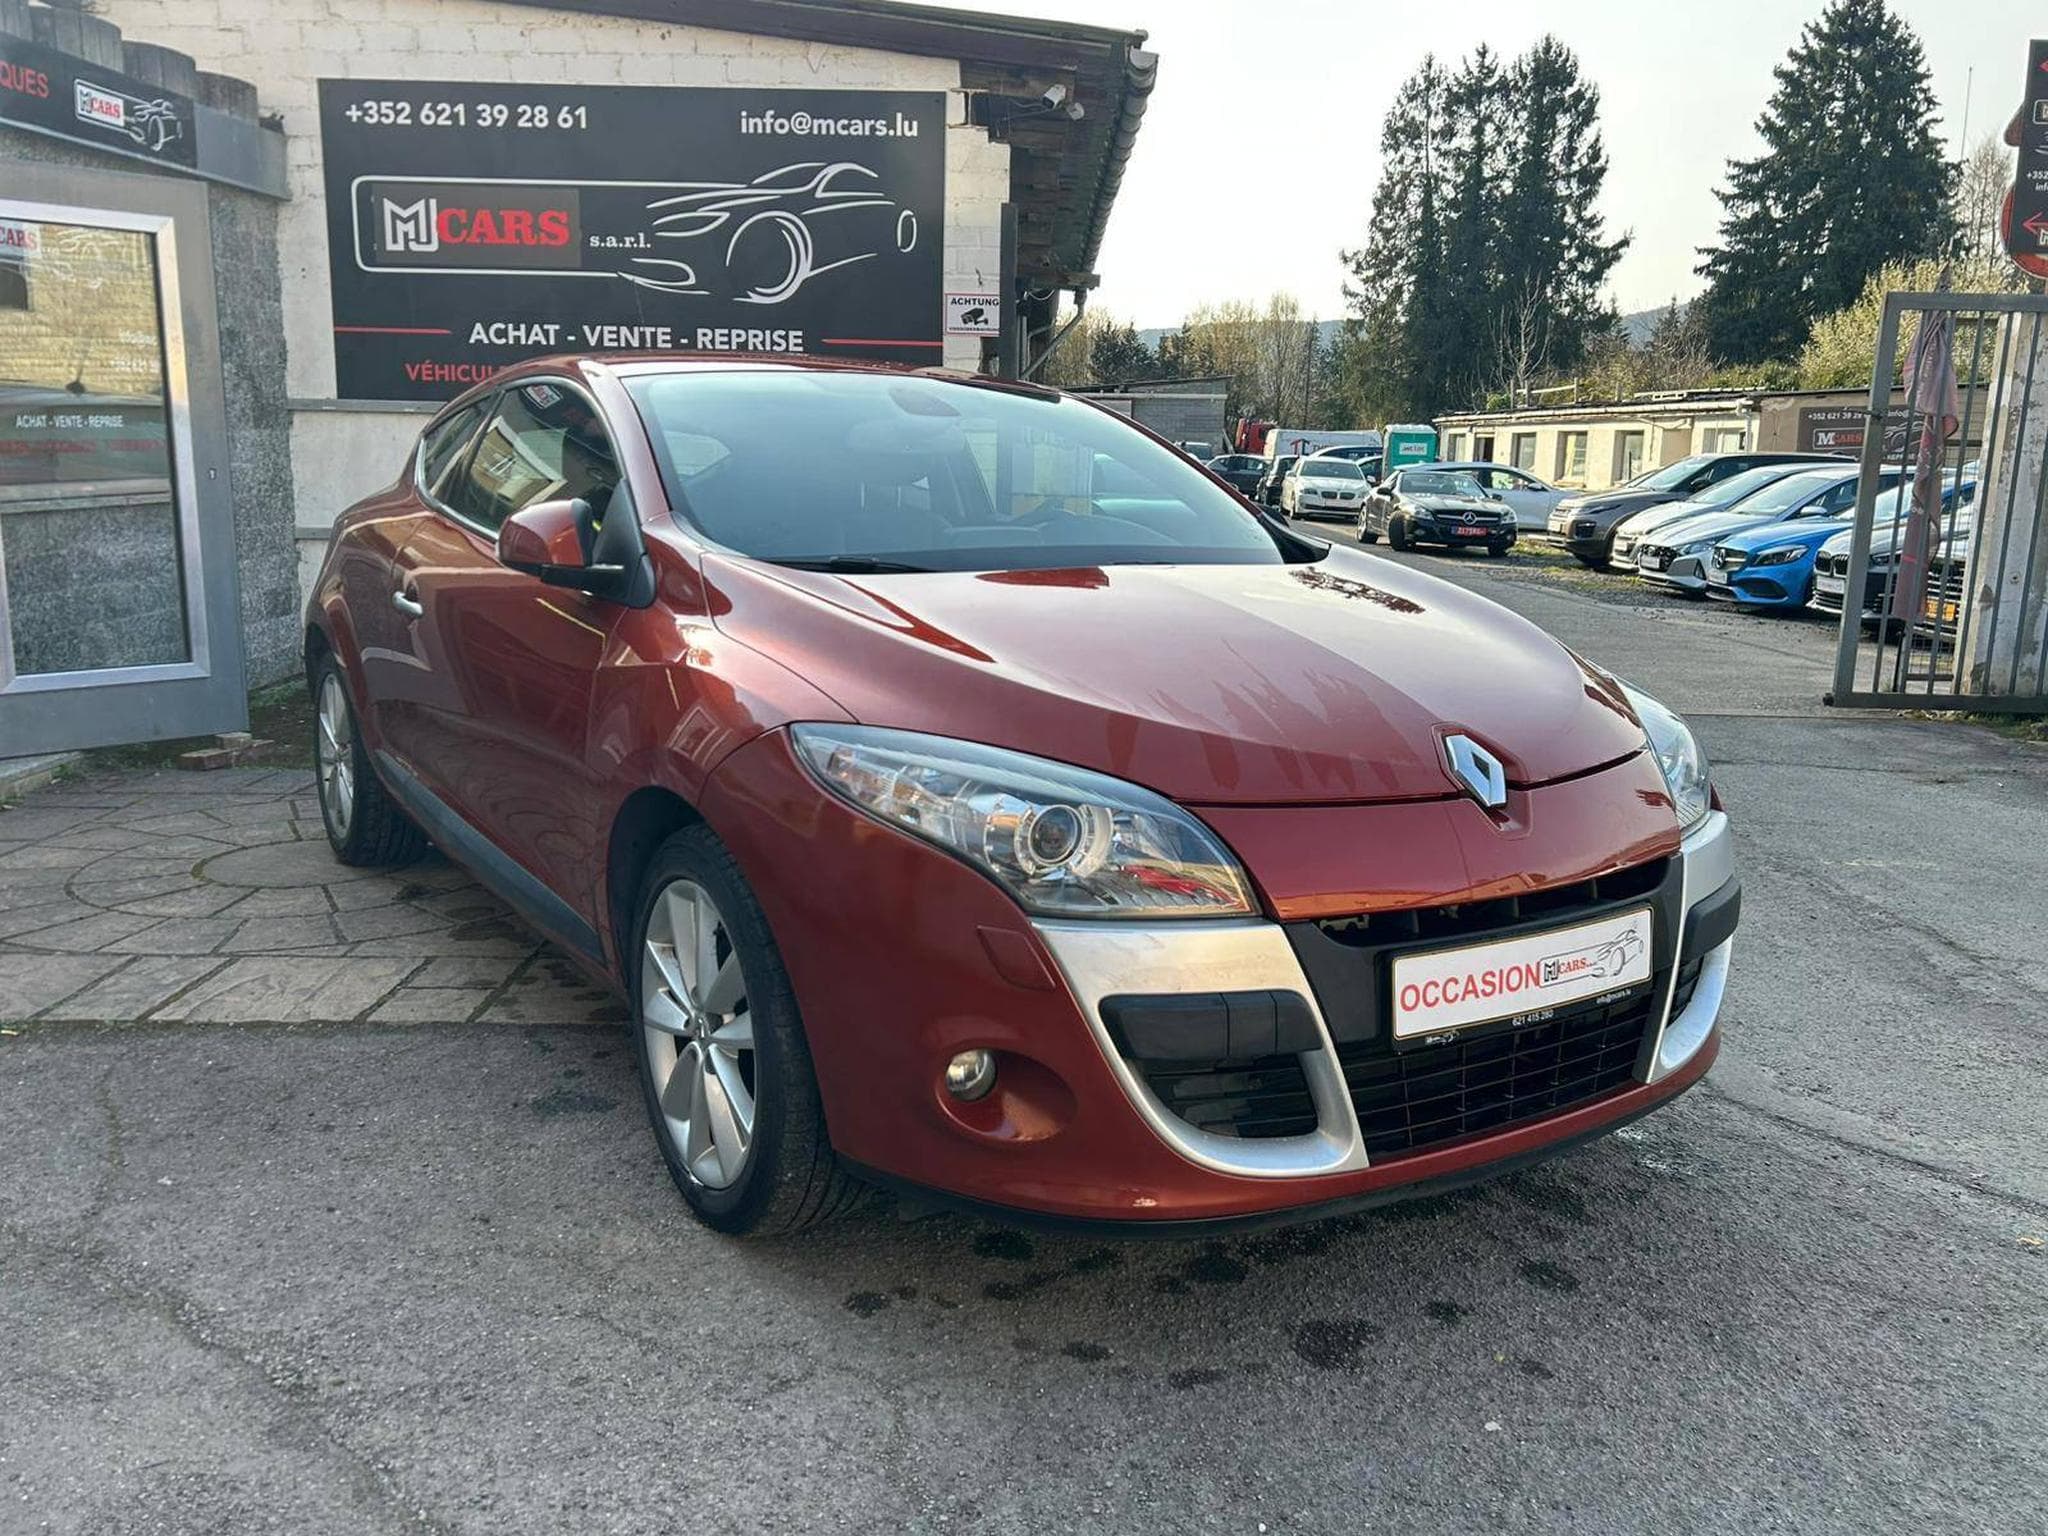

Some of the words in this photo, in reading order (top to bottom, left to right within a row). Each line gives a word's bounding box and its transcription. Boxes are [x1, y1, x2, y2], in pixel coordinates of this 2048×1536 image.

[0, 59, 48, 98] QUES
[345, 100, 412, 125] +352
[420, 102, 466, 126] 621
[477, 103, 509, 127] 39
[517, 105, 549, 128] 28
[557, 106, 587, 129] 61
[740, 109, 918, 137] info@mcars.lu
[437, 208, 570, 246] CARS
[589, 233, 651, 249] s.a.r.l.
[951, 297, 1000, 306] ACHTUNG
[469, 322, 560, 345] ACHAT
[582, 325, 673, 348] VENTE
[696, 328, 804, 352] REPRISE
[16, 415, 47, 428] ACHAT
[54, 415, 83, 428] VENTE
[88, 415, 124, 428] REPRISE
[1400, 961, 1541, 1012] OCCASION
